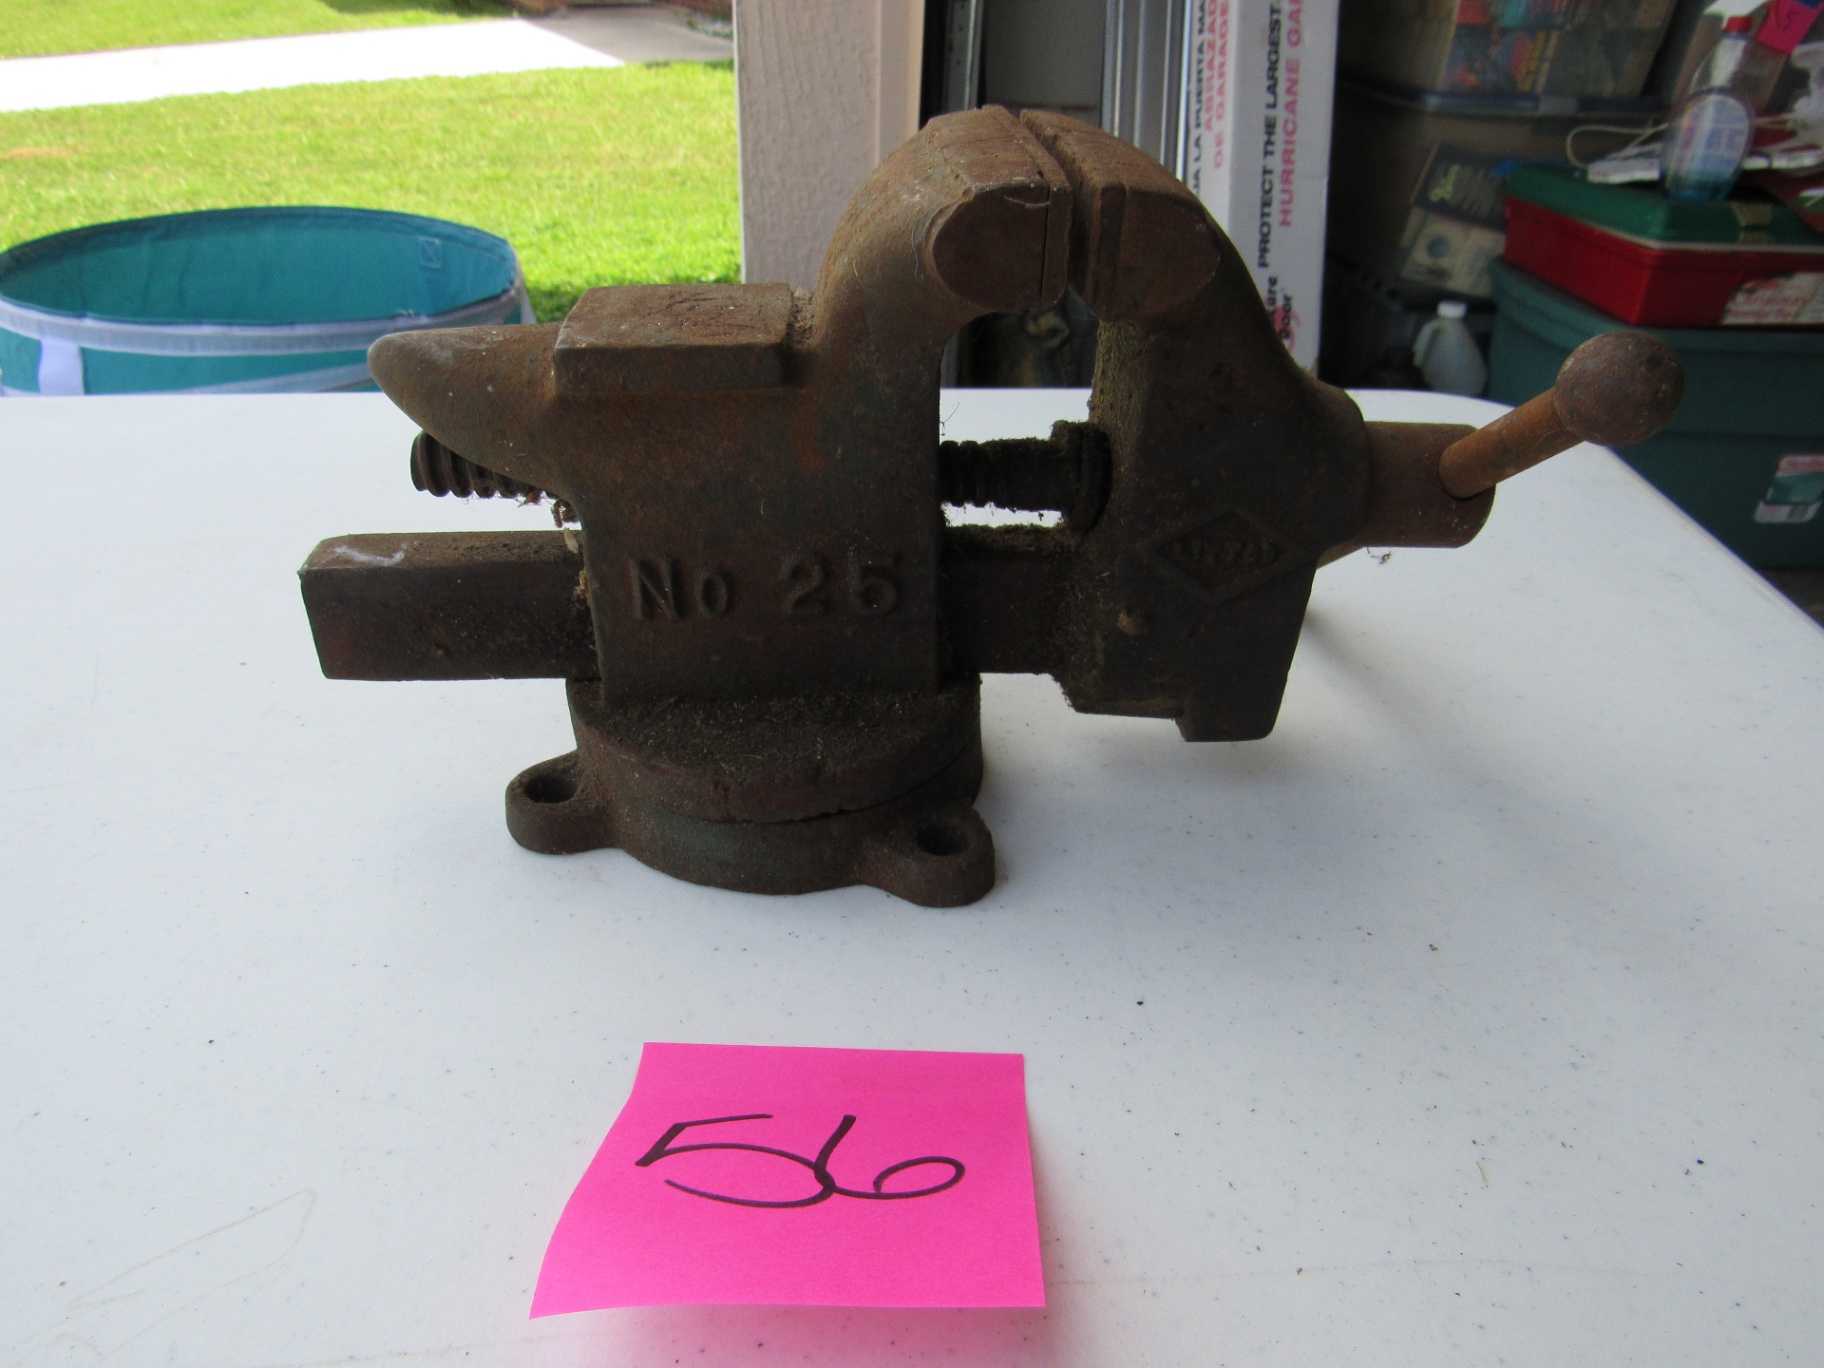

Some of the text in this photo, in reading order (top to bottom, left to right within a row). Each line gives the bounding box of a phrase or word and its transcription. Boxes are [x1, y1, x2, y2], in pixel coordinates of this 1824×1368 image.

[1257, 4, 1281, 268] PROTECT THE LARGEST
[1279, 58, 1300, 227] HURRICANE
[627, 547, 899, 620] No 25
[634, 1112, 966, 1209] 56
